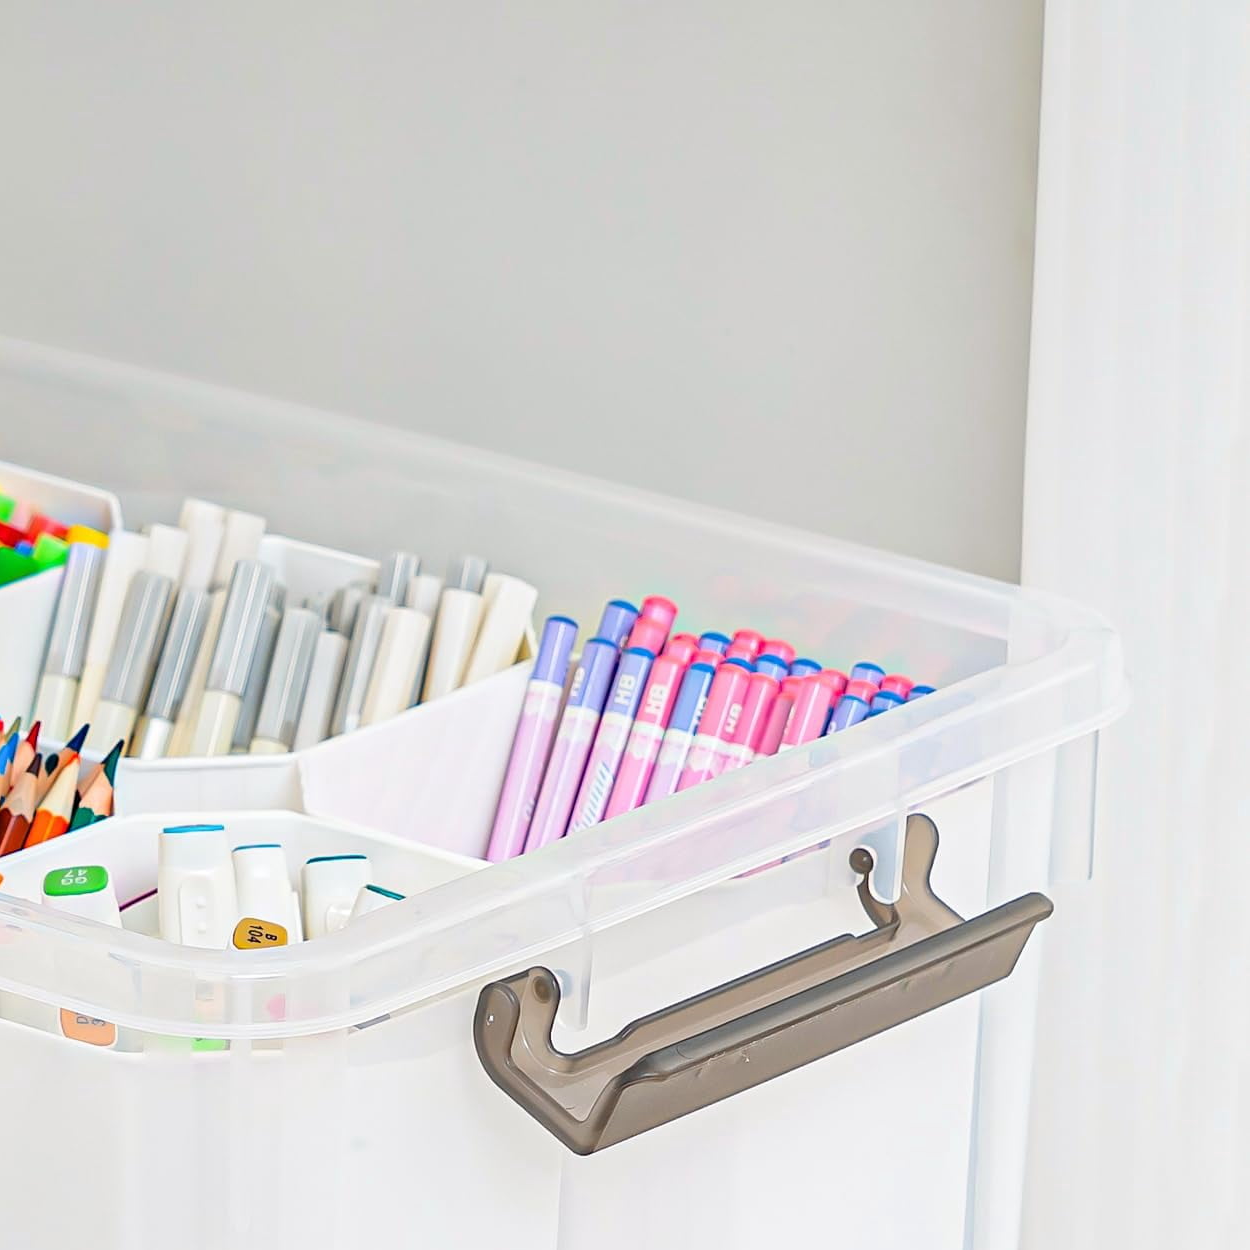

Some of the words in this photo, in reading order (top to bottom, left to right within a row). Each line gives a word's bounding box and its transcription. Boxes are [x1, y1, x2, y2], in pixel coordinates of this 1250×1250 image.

[613, 674, 636, 706] HB
[644, 684, 668, 714] HB
[247, 925, 263, 944] 104
